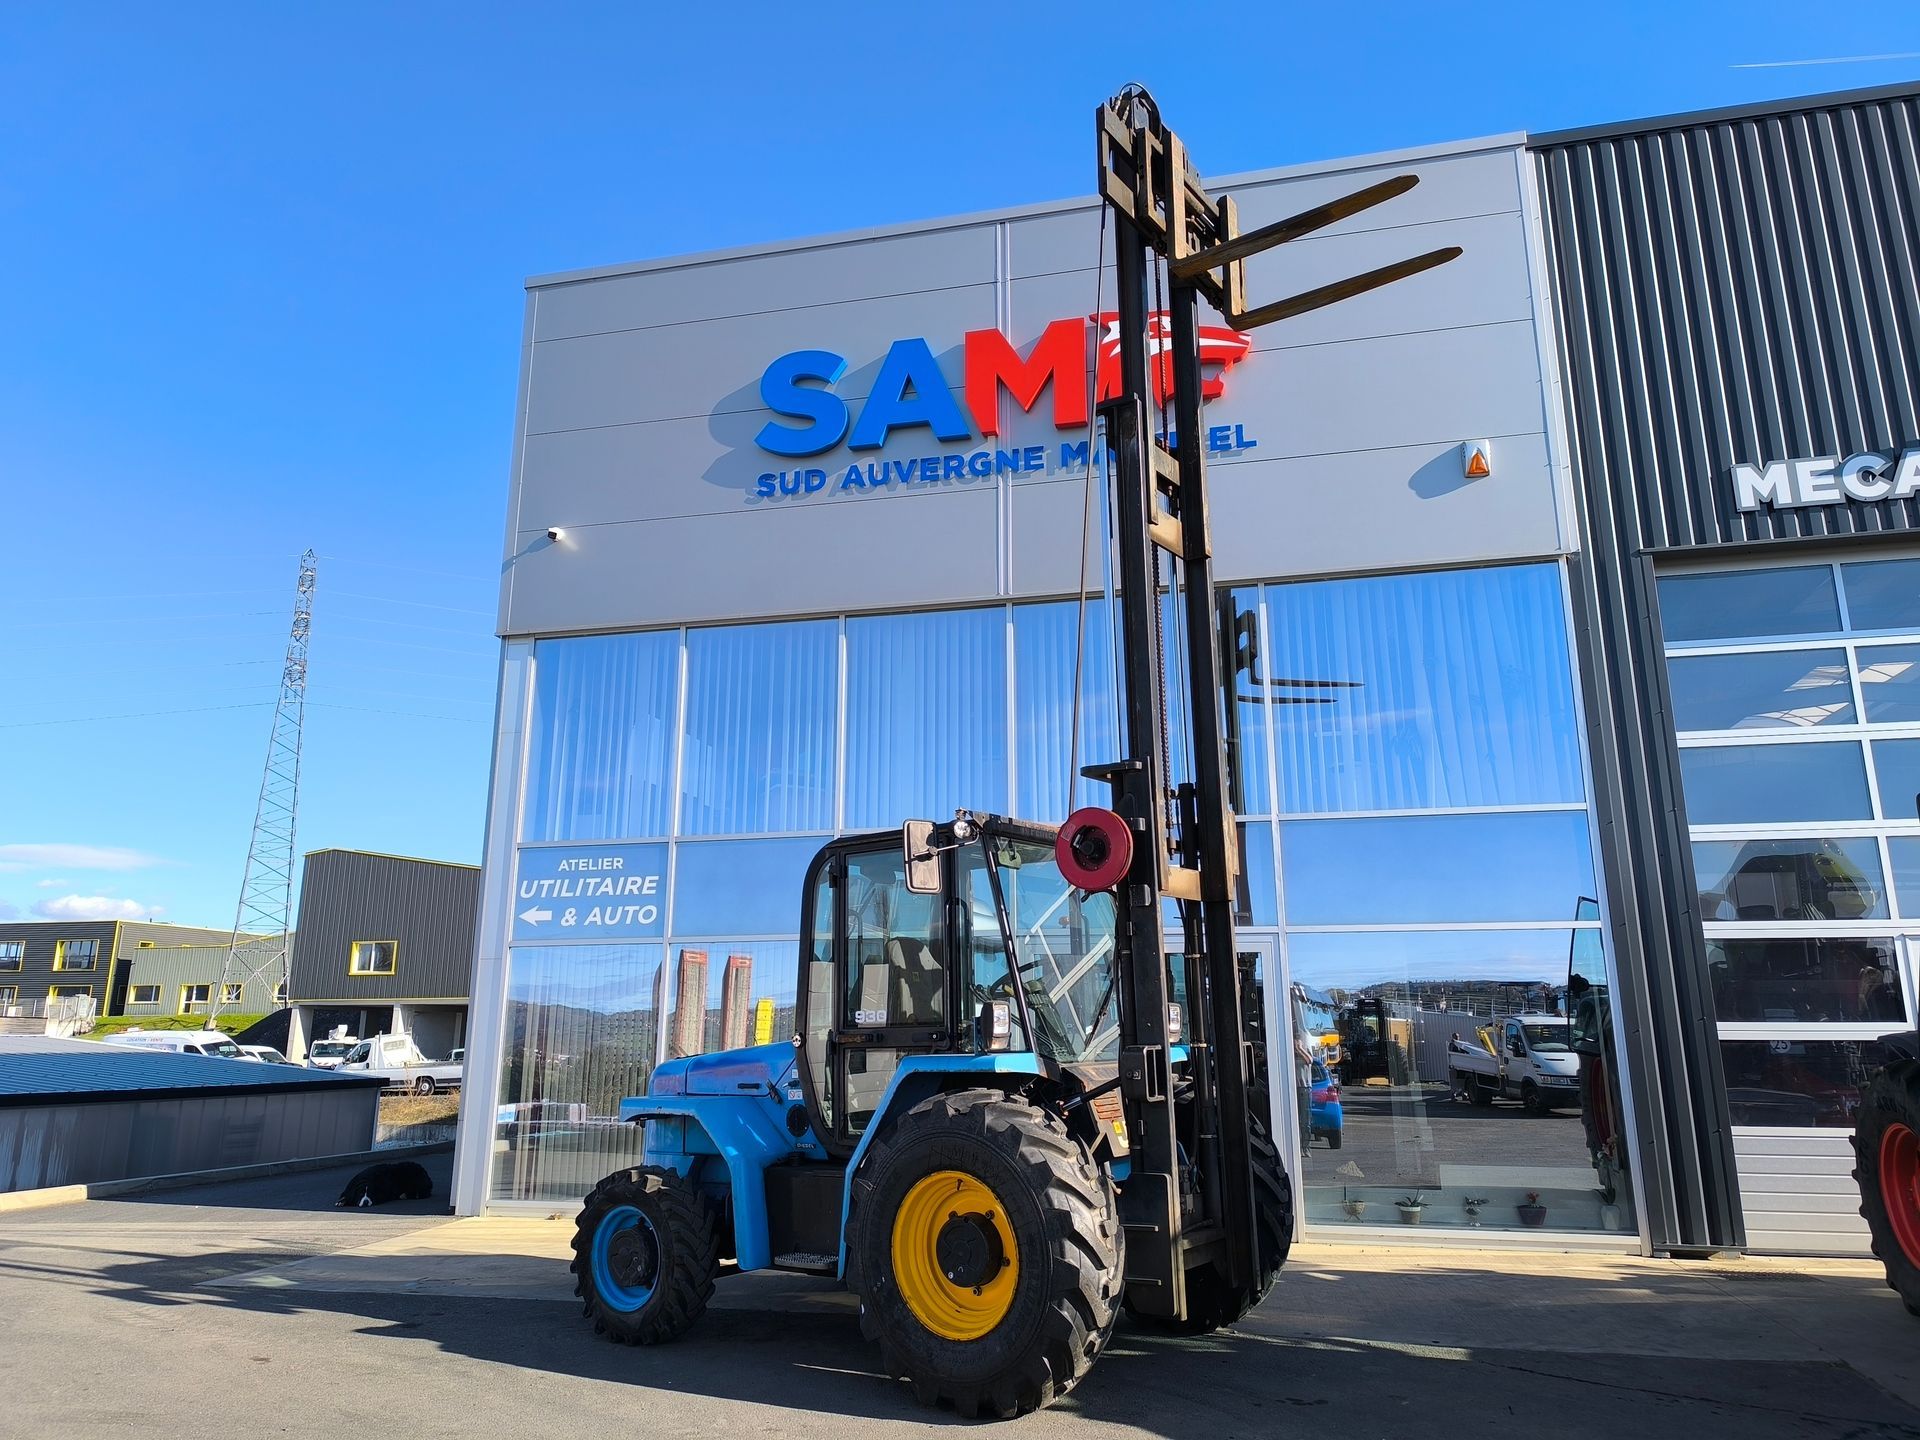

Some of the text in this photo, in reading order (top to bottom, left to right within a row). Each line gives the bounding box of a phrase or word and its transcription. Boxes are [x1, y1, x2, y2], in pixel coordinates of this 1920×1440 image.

[754, 318, 1089, 458] SAM
[756, 468, 827, 498] SUD
[841, 445, 1046, 490] AUVERGNE
[558, 857, 624, 872] ATELIER
[520, 875, 659, 898] UTILITAIRE
[560, 905, 658, 927] & AUTO
[855, 1010, 887, 1024] 930
